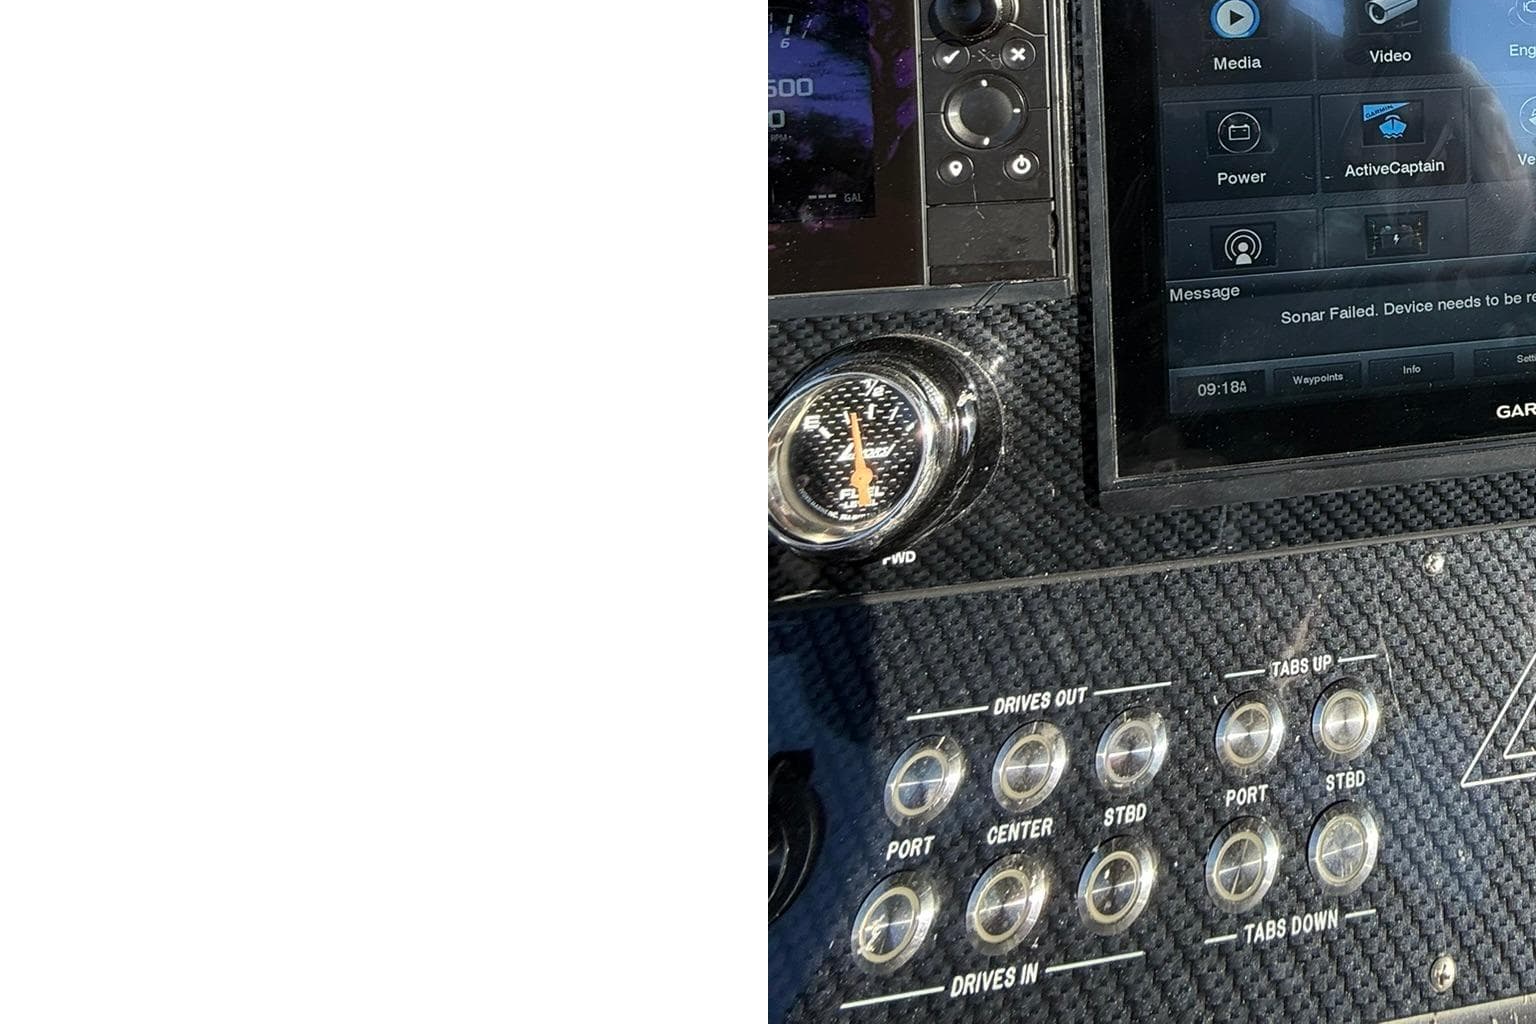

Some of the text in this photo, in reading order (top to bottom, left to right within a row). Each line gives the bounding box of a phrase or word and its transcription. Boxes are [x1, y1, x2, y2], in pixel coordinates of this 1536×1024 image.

[780, 37, 790, 48] 6
[1213, 56, 1262, 70] Media
[1369, 49, 1411, 63] Video
[1217, 171, 1266, 185] Power
[1345, 159, 1445, 178] ActiveCaptain
[844, 192, 863, 203] GAL
[1170, 285, 1240, 303] Message
[1281, 309, 1325, 325] Sonar
[1329, 305, 1379, 321] Failed.
[1384, 300, 1433, 316] Device
[1437, 296, 1481, 311] needs
[1485, 294, 1500, 307] to
[1503, 291, 1522, 305] be
[1293, 372, 1344, 386] Waypoints
[1402, 364, 1421, 375] Info
[1272, 656, 1332, 677] TABS UP
[993, 687, 1088, 715] DRIVES OUT
[1326, 770, 1366, 791] STBD
[1225, 785, 1268, 806] PORT
[1104, 804, 1148, 826] STBD
[987, 818, 1053, 844] CENTER
[886, 836, 935, 860] PORT
[1244, 909, 1339, 944] TABS DOWN
[951, 963, 1039, 997] DRIVES IN
